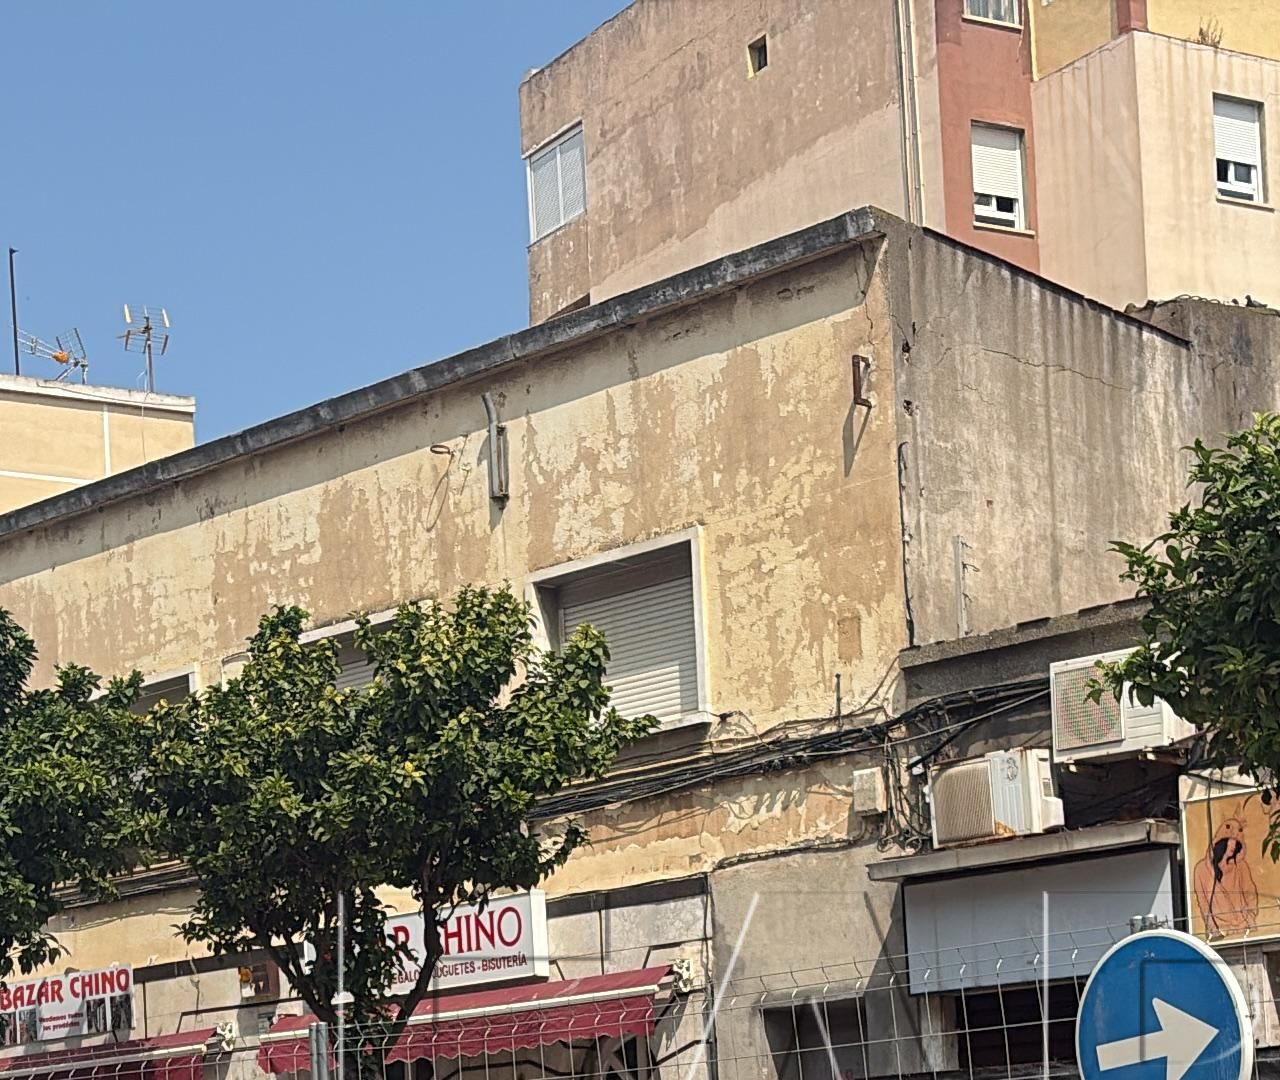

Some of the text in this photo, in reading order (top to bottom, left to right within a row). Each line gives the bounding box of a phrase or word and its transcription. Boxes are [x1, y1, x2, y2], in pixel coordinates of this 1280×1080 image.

[442, 906, 522, 957] HINO
[0, 968, 130, 1011] BAZAR CHINO
[391, 968, 421, 986] EGALO
[482, 951, 528, 972] BISUTERÍA
